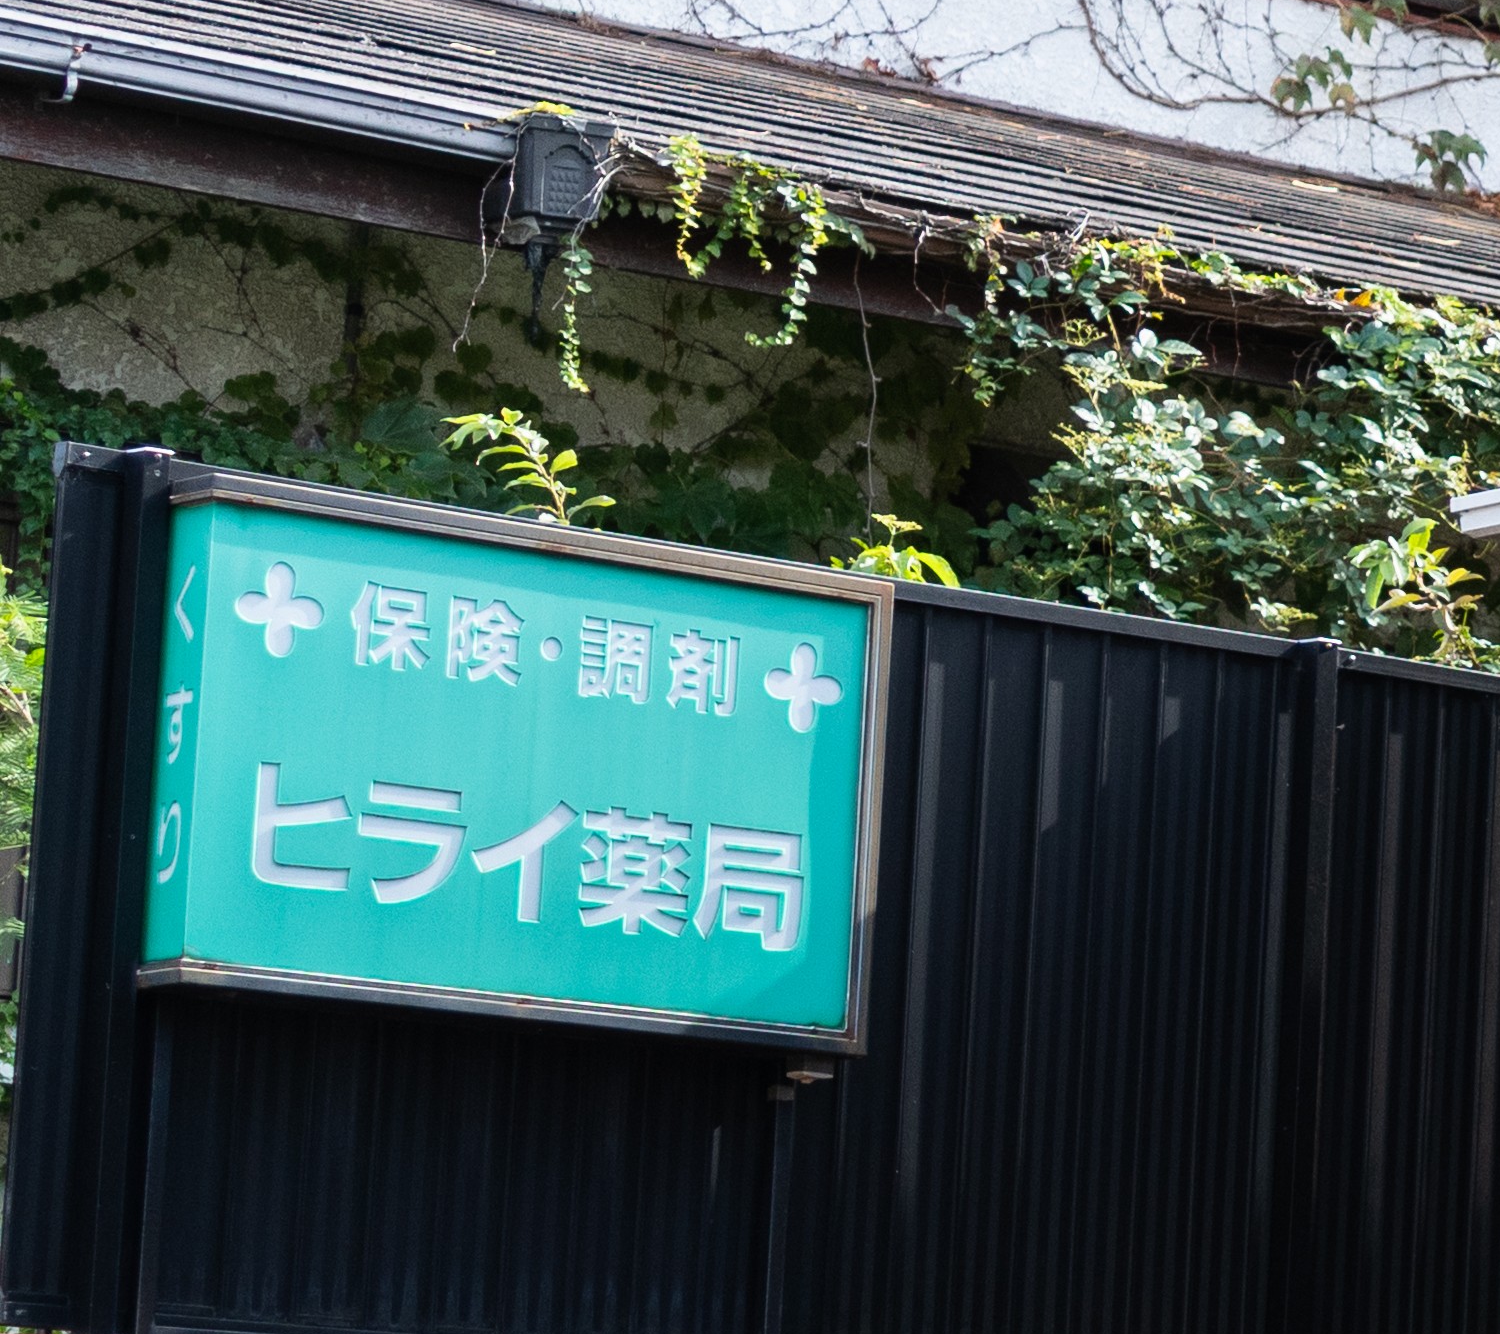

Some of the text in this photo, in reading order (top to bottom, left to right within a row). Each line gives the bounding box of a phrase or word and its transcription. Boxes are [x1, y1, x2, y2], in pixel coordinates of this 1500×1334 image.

[157, 564, 195, 886] くすり
[350, 581, 740, 717] 保険・調剤
[251, 761, 805, 953] ヒライ薬局
